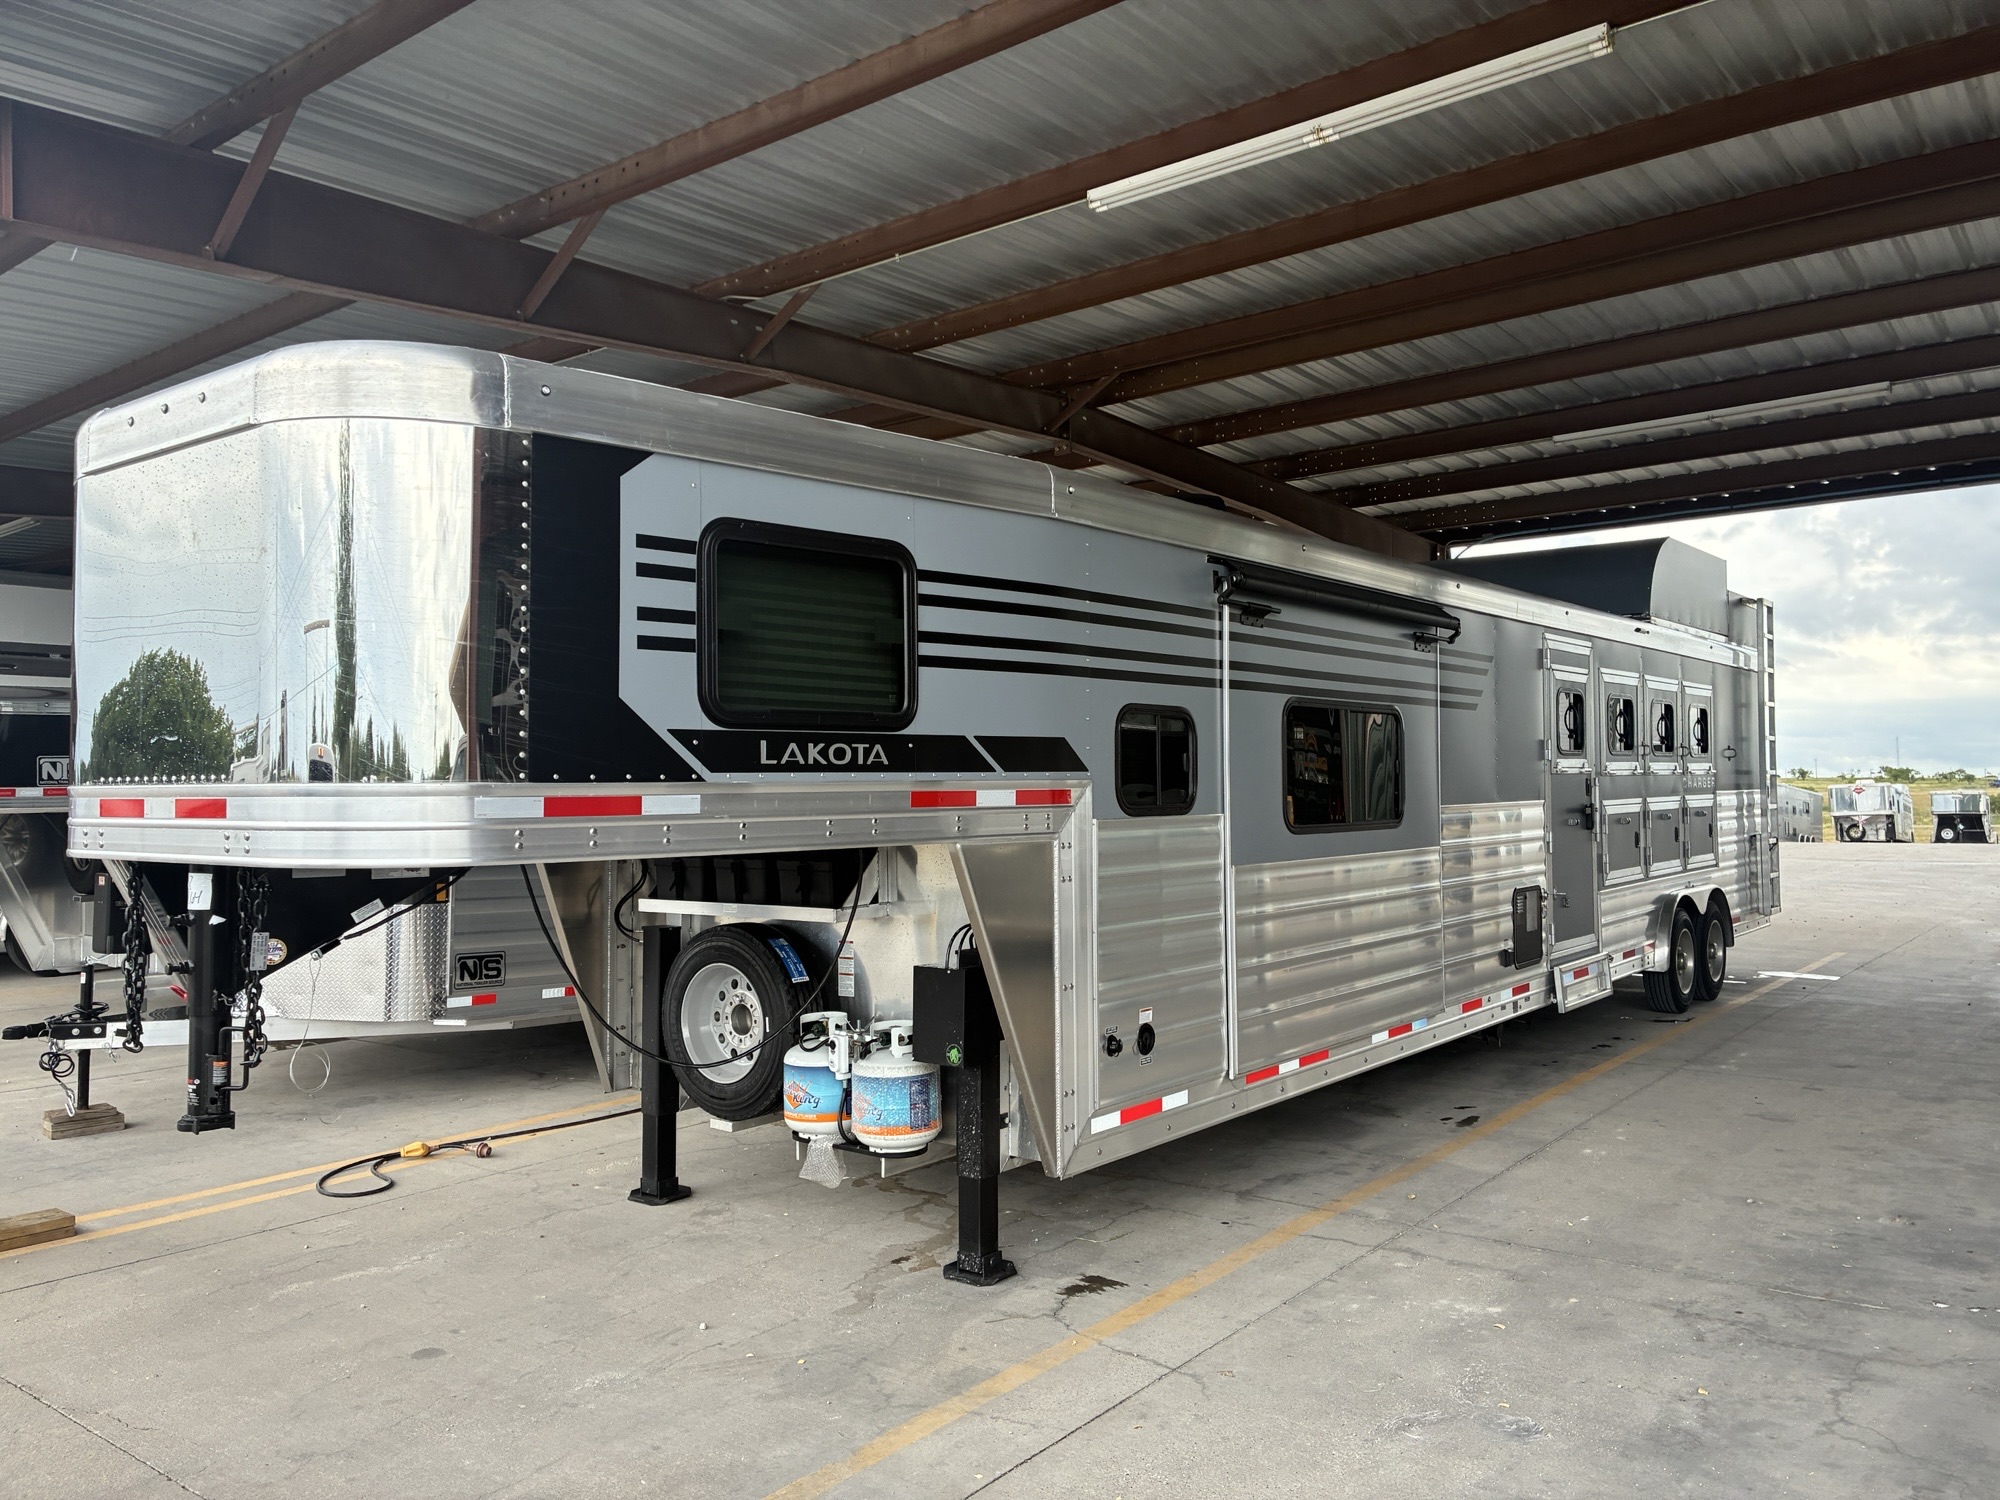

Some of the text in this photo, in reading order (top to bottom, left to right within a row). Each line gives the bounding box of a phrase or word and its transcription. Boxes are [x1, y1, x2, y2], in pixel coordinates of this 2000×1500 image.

[760, 740, 889, 765] LAKOTA
[40, 758, 70, 780] NT
[1682, 777, 1715, 788] CHARGER
[458, 954, 503, 982] NTS
